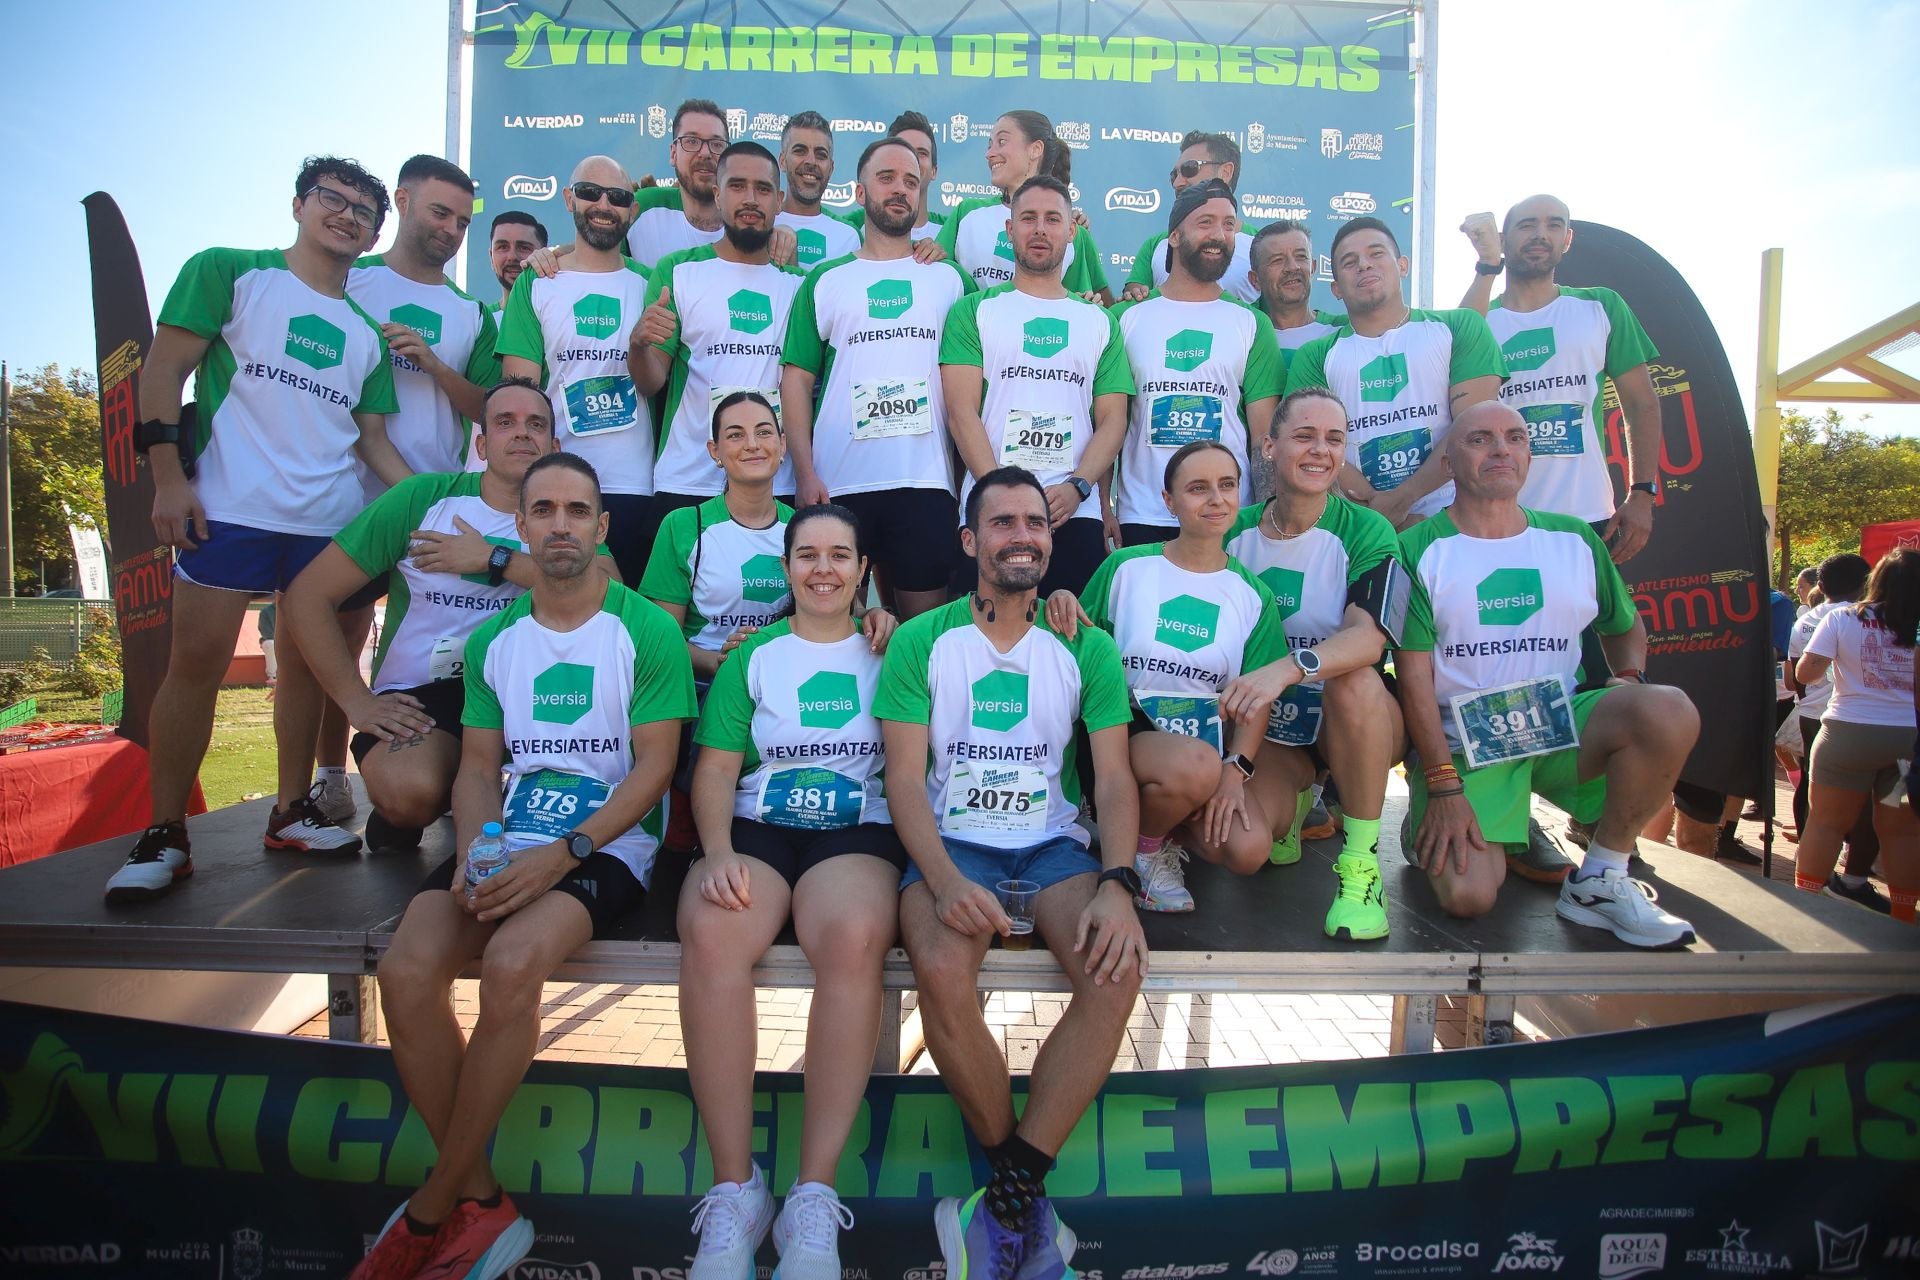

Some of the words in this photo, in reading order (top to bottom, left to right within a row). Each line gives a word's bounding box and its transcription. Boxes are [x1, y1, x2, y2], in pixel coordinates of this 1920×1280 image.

[641, 23, 939, 75] CARRERA
[951, 33, 1028, 78] DE
[1039, 34, 1381, 92] EMPRESAS
[504, 116, 523, 128] LA
[526, 114, 584, 129] VERDAD
[749, 123, 784, 133] ATLETISM
[1056, 132, 1090, 141] TLETISMO
[1101, 128, 1120, 140] LA
[1123, 128, 1183, 144] VERDAD
[512, 182, 550, 194] VIDAL
[977, 185, 1002, 196] GLOBA
[1113, 195, 1153, 206] VIDAL
[1276, 195, 1306, 206] GLOBAL
[797, 244, 822, 255] ersia
[867, 295, 908, 308] eversia
[574, 314, 616, 326] eversia
[728, 309, 767, 321] eversia
[287, 331, 337, 360] eversia
[847, 327, 936, 346] #EVERSIATEAM
[1023, 332, 1063, 345] eversia
[556, 348, 629, 362] #EVERSIATEA
[706, 343, 782, 357] #EVERSIATEA
[1164, 348, 1205, 359] eversia
[1000, 366, 1085, 388] #EVERSIATEAM
[1360, 373, 1402, 391] eversia
[1142, 381, 1229, 397] #EVERSIATEAM
[1498, 374, 1587, 399] VERSIATEAM
[585, 392, 624, 412] 394
[867, 399, 918, 418] 2080
[1168, 411, 1207, 428] 387
[1347, 404, 1438, 433] EVERSIATEAM
[1526, 420, 1567, 438] 395
[1018, 430, 1064, 449] 2079
[1378, 448, 1421, 472] 392
[741, 577, 785, 588] eversia
[1636, 574, 1710, 592] ATLETISMO
[1476, 592, 1536, 611] eversia
[1632, 582, 1759, 632] AMU
[1156, 617, 1209, 639] eversia
[1444, 637, 1569, 658] #EVERSIATEAM
[1646, 629, 1745, 656] orriendo
[532, 690, 587, 705] eversia
[798, 697, 853, 712] eversia
[971, 699, 1022, 713] eversia
[1270, 699, 1298, 721] 89
[1488, 706, 1541, 735] 391
[982, 770, 1019, 783] CARRERA
[527, 788, 578, 815] 378
[786, 788, 836, 811] 381
[966, 788, 1030, 812] 2075
[1206, 1061, 1920, 1196] EMPRESAS
[1356, 1240, 1480, 1261] Brocalsa
[1606, 1237, 1661, 1252] AQUA
[1491, 1251, 1565, 1273] jokey
[1608, 1250, 1658, 1264] DEUS
[1685, 1249, 1793, 1270] ESTRELLA
[284, 1261, 327, 1272] Murcia
[1121, 1261, 1230, 1280] atalayas
[1706, 1262, 1719, 1271] DE
[1720, 1264, 1768, 1276] LEVANTE
